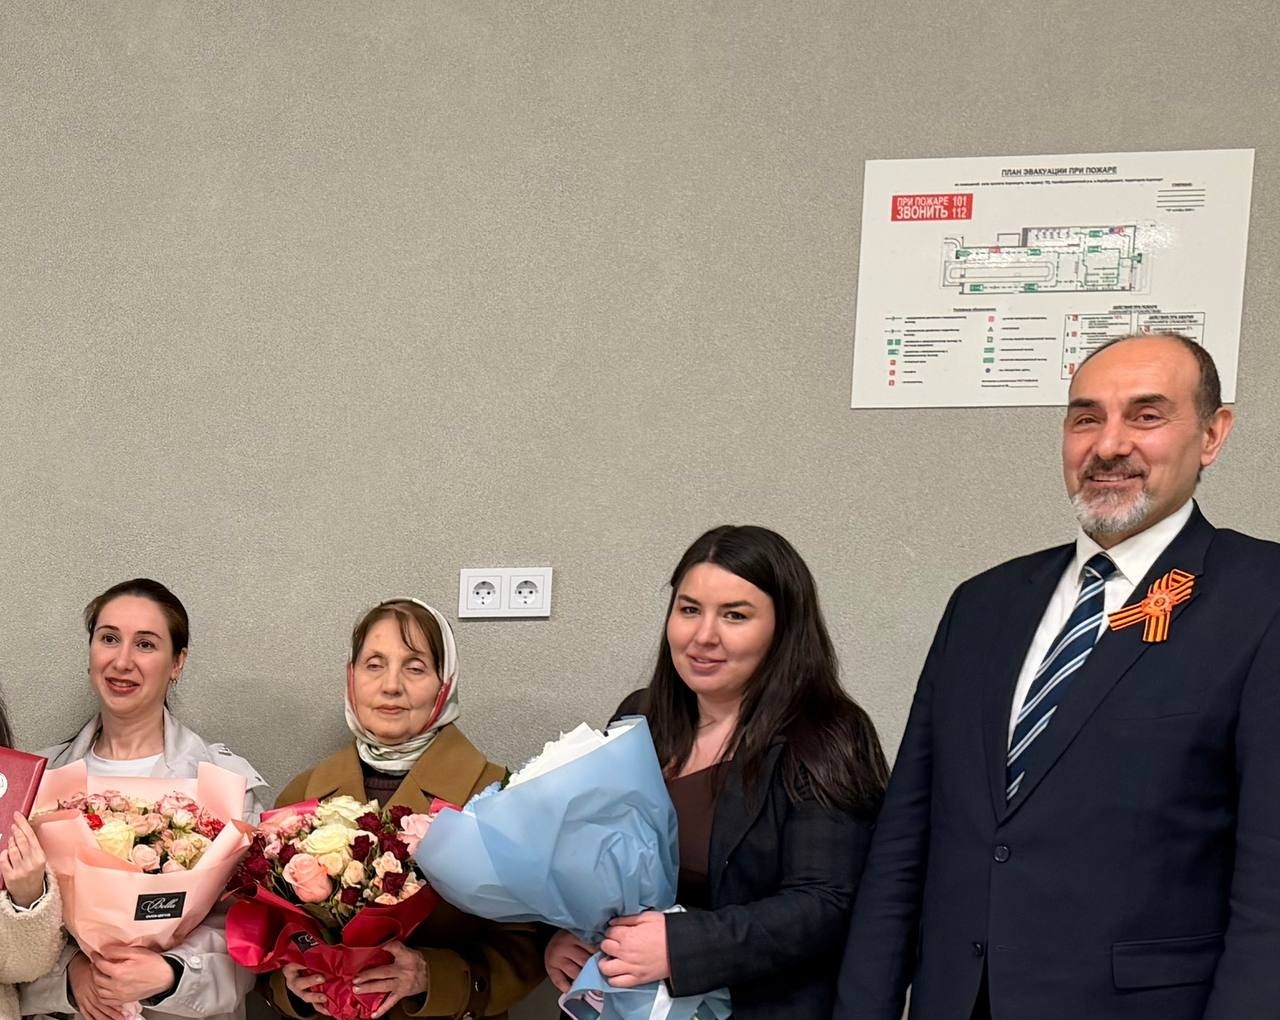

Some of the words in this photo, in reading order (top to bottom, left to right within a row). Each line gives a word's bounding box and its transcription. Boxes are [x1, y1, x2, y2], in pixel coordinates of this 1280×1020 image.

[1023, 168, 1067, 176] ЭВАКУАЦИИ
[1069, 167, 1084, 175] ПРИ
[1085, 166, 1117, 174] ПОЖАРЕ
[896, 197, 913, 206] ПРИ
[914, 196, 949, 206] ПОЖАРЕ
[952, 196, 967, 206] 101
[896, 206, 949, 219] ЗВОНИТЬ
[952, 207, 967, 218] 112
